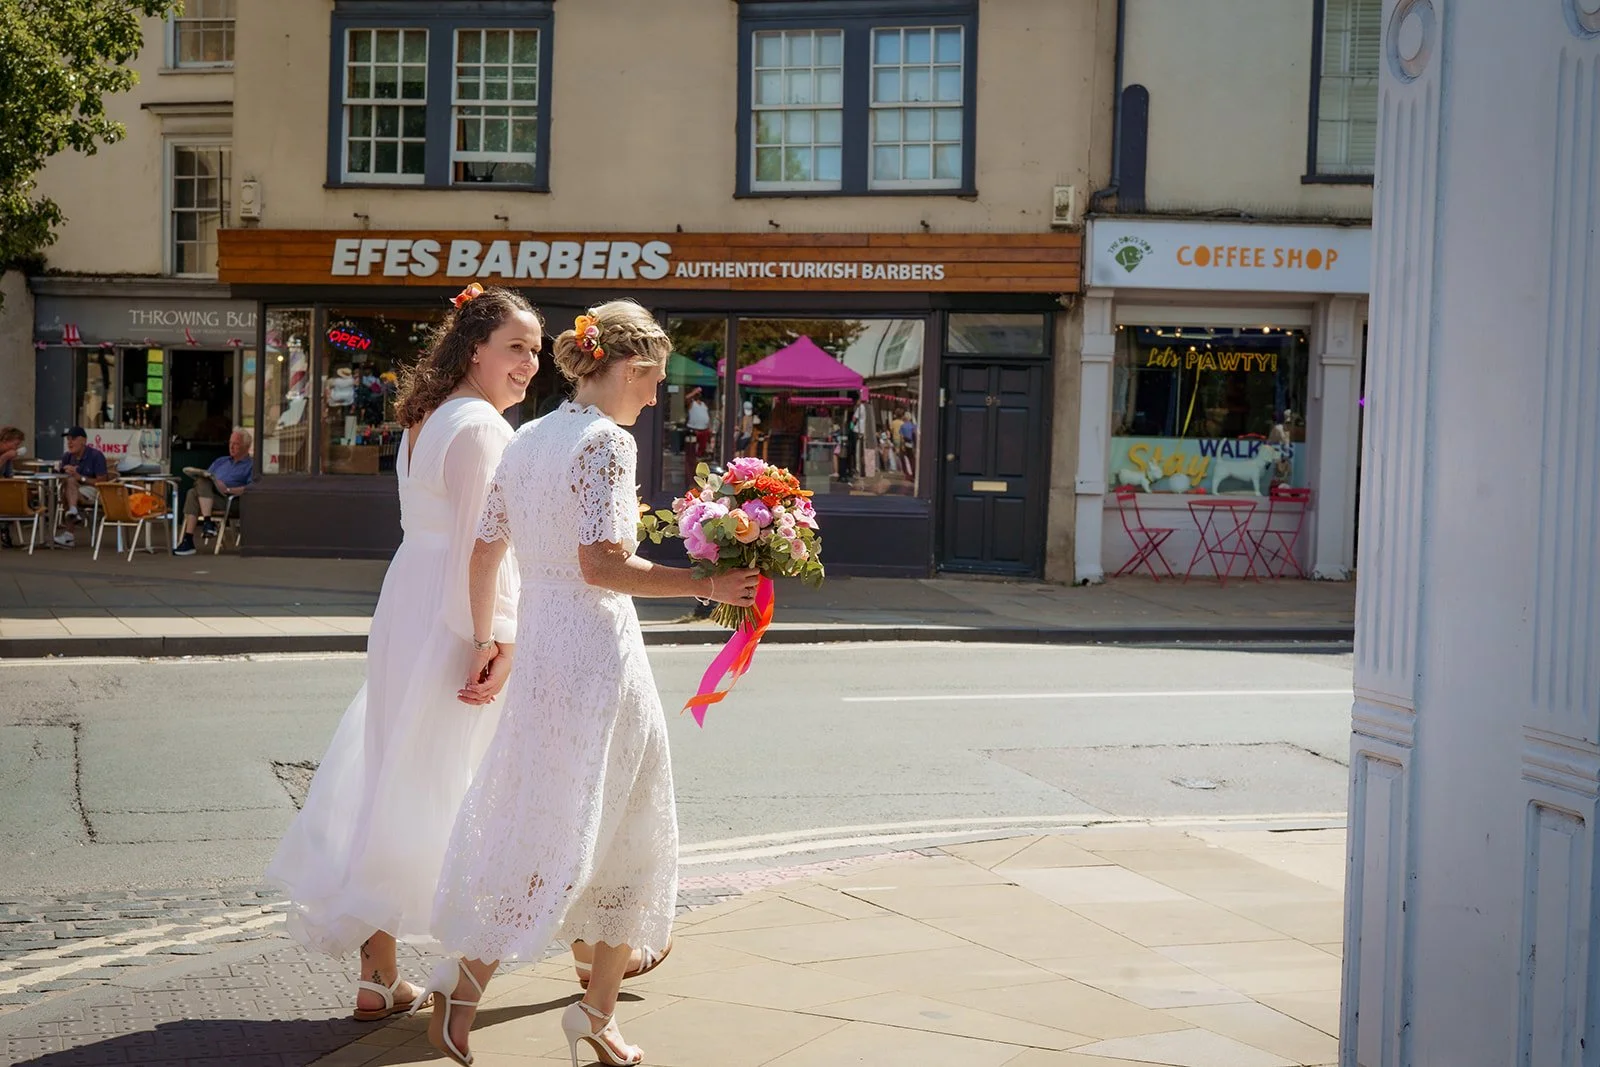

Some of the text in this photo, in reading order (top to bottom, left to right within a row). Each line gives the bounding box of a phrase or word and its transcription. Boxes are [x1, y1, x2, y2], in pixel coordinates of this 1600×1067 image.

[331, 238, 672, 280] EFES BARBERS
[675, 261, 945, 281] AUTHENTIC TURKISH BARBERS
[1176, 245, 1338, 271] COFFEE SHOP
[128, 309, 219, 327] THROWING
[329, 330, 371, 350] OPEN
[1146, 346, 1278, 372] Let's PAWTY!
[1127, 442, 1211, 487] Stay
